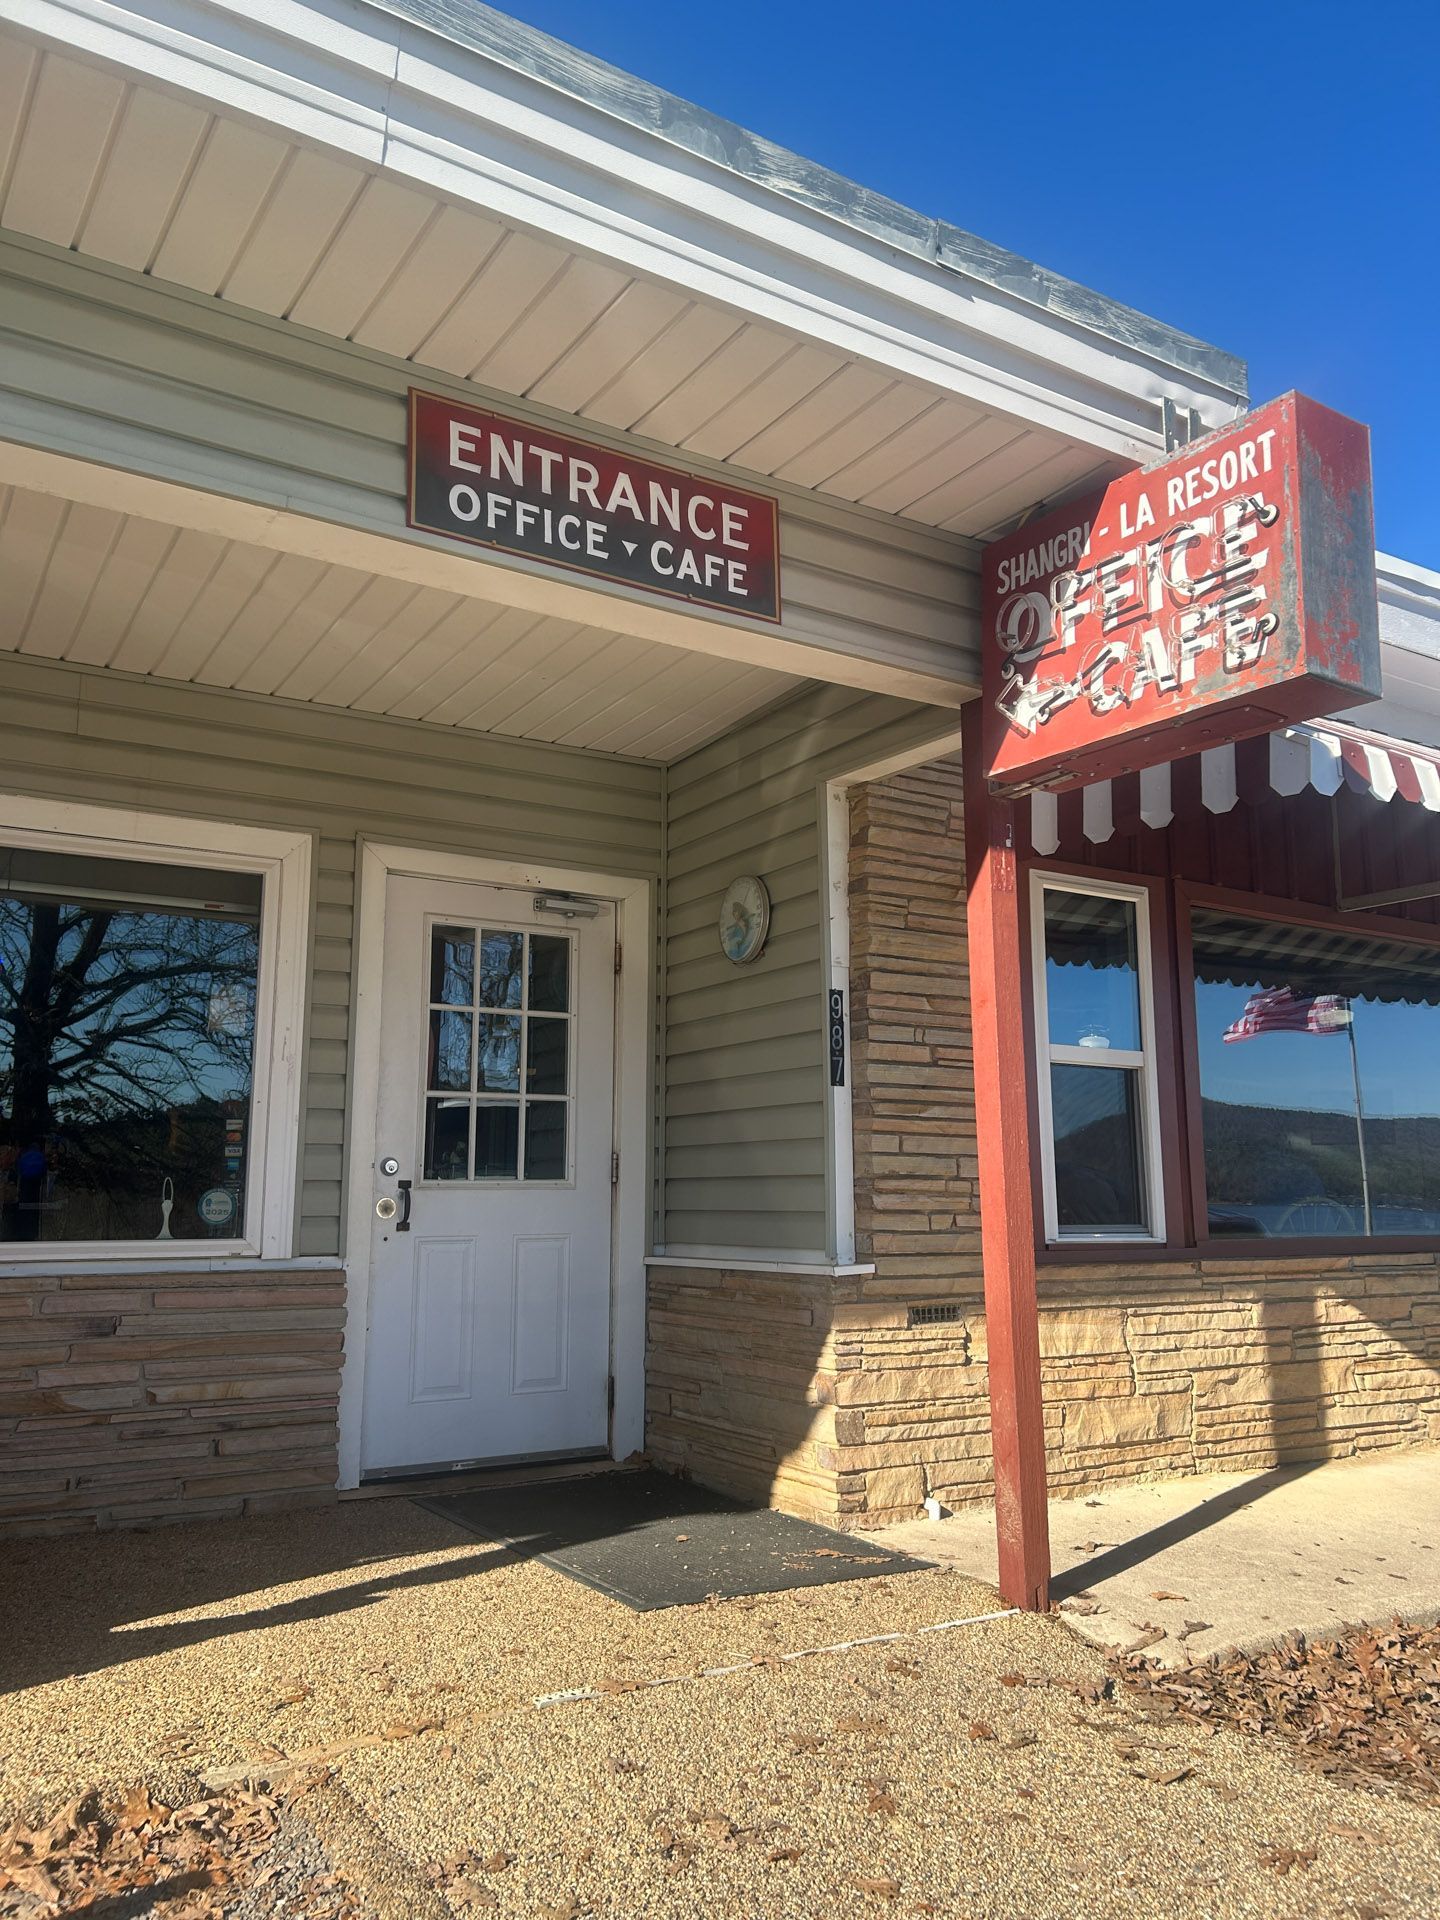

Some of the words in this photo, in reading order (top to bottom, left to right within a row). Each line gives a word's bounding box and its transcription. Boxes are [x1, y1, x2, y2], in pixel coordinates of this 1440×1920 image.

[449, 420, 749, 551] ENTRANCE
[449, 484, 609, 559] OFFICE
[650, 540, 748, 596] CAFE
[997, 521, 1091, 594] SHANGRI
[1120, 493, 1155, 539] LA
[1168, 429, 1276, 516] RESORT
[998, 492, 1272, 663] OFFICE
[1080, 585, 1272, 713] CAFE
[831, 994, 843, 1082] 987
[206, 1208, 229, 1216] 2025
